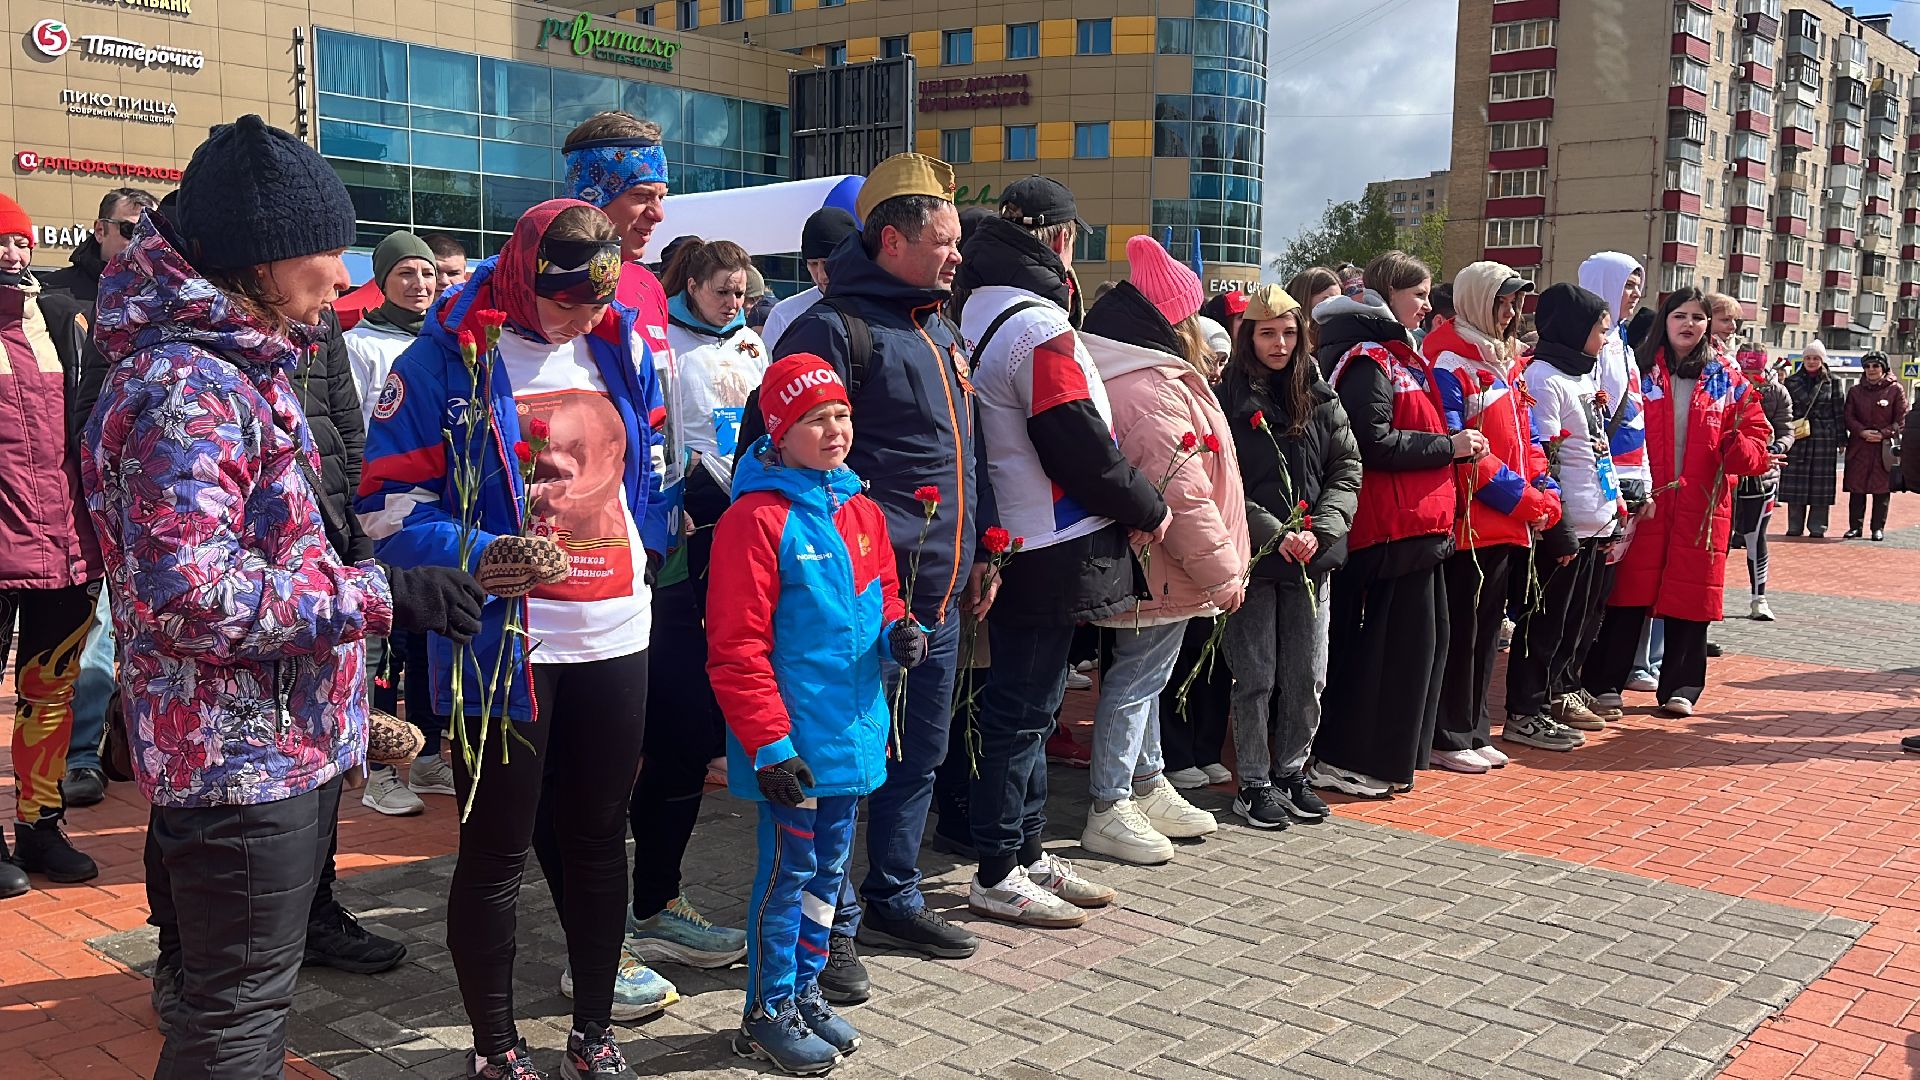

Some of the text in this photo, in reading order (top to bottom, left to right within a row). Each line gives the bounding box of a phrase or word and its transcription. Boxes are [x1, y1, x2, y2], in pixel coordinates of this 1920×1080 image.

[63, 89, 178, 115] ПИКО ПИЦЦА
[69, 106, 129, 119] СОВРЕМЕННАЯ
[44, 157, 182, 181] АЛЬФАСТРАХОВ
[44, 223, 95, 247] ВАЙ
[1210, 279, 1243, 292] EAST
[568, 555, 605, 565] овиков
